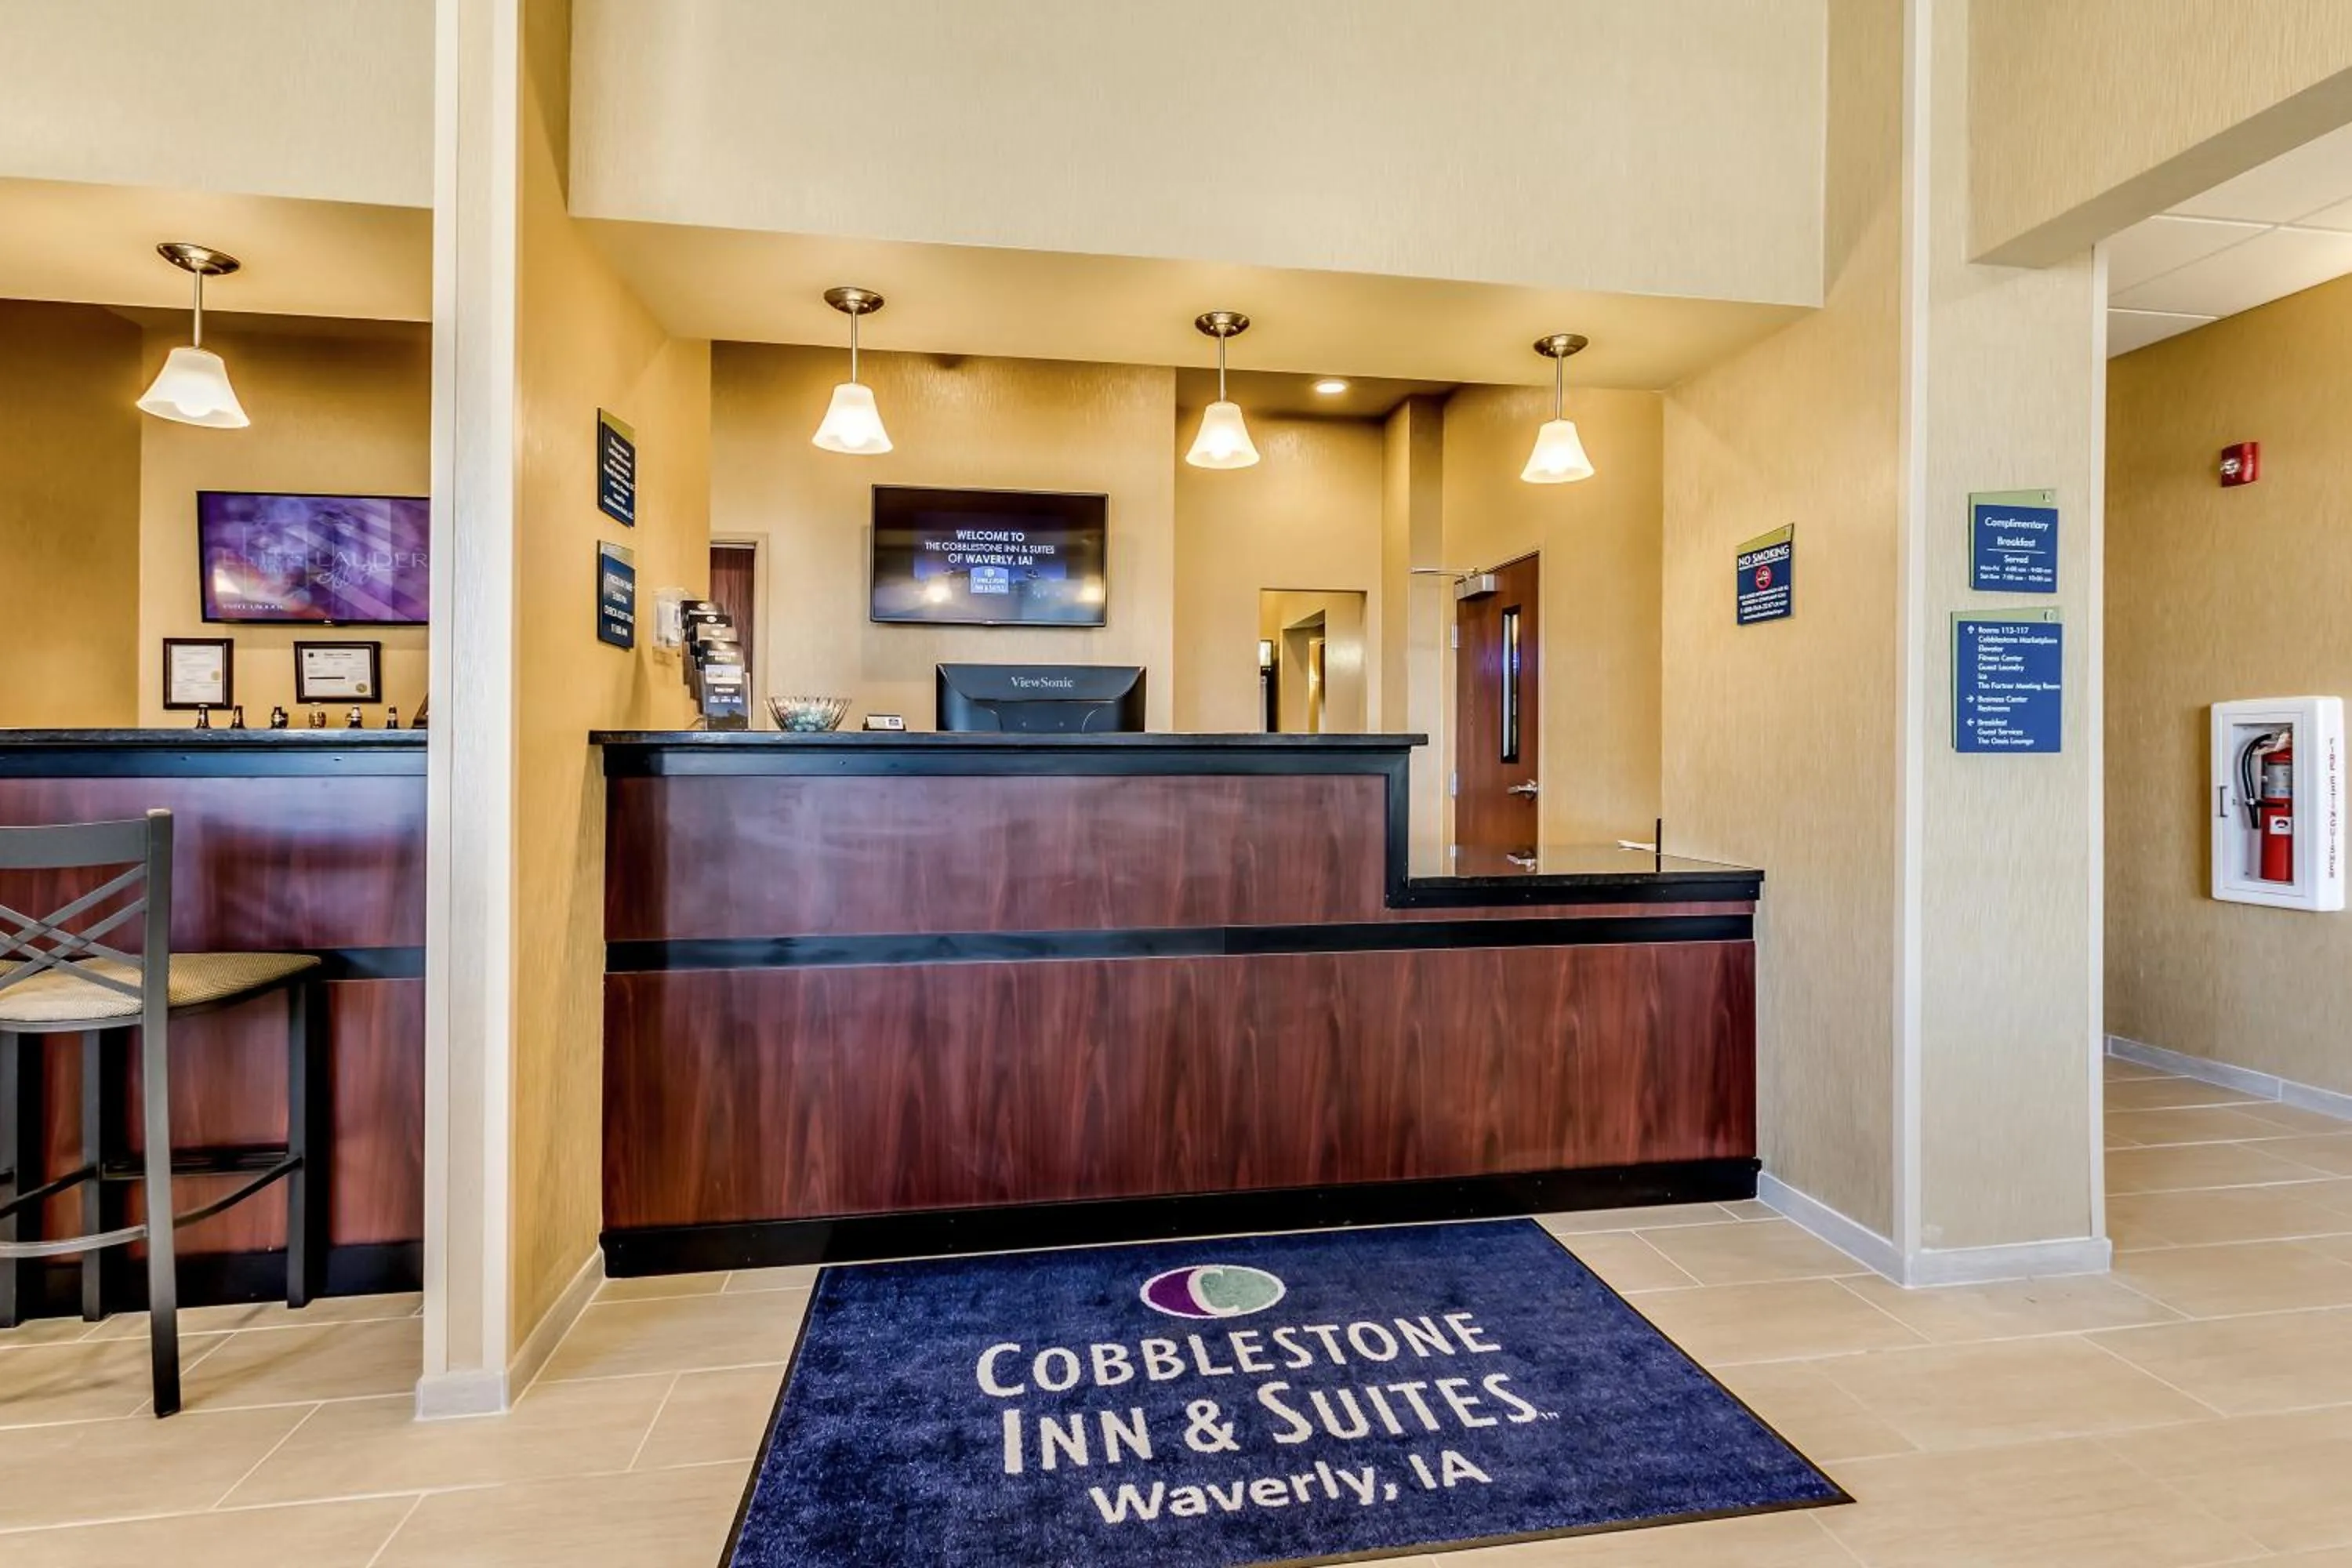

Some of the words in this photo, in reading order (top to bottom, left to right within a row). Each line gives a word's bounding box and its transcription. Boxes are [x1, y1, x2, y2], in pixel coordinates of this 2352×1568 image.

[1984, 517, 2049, 532] Complimentary
[956, 530, 1008, 541] WELCOME
[1011, 532, 1025, 542] TO
[1997, 536, 2036, 547] Breakfast
[925, 542, 941, 550] THE
[942, 542, 1002, 553] COBBLESTONE
[1029, 545, 1054, 554] SUITES
[948, 553, 963, 564] OF
[965, 554, 1016, 565] WAVERLY,
[1738, 557, 1751, 567] NO
[1752, 545, 1790, 564] SMOKING
[2004, 554, 2029, 564] Served
[1978, 626, 2000, 634] Rooms
[1011, 676, 1073, 688] ViewSonic
[976, 1312, 1502, 1398] COBBLESTONE
[1002, 1406, 1153, 1475] INN
[1183, 1398, 1241, 1454] &
[1256, 1372, 1538, 1445] SUITES
[1088, 1460, 1399, 1526] Waverly,
[1409, 1449, 1494, 1490] IA
